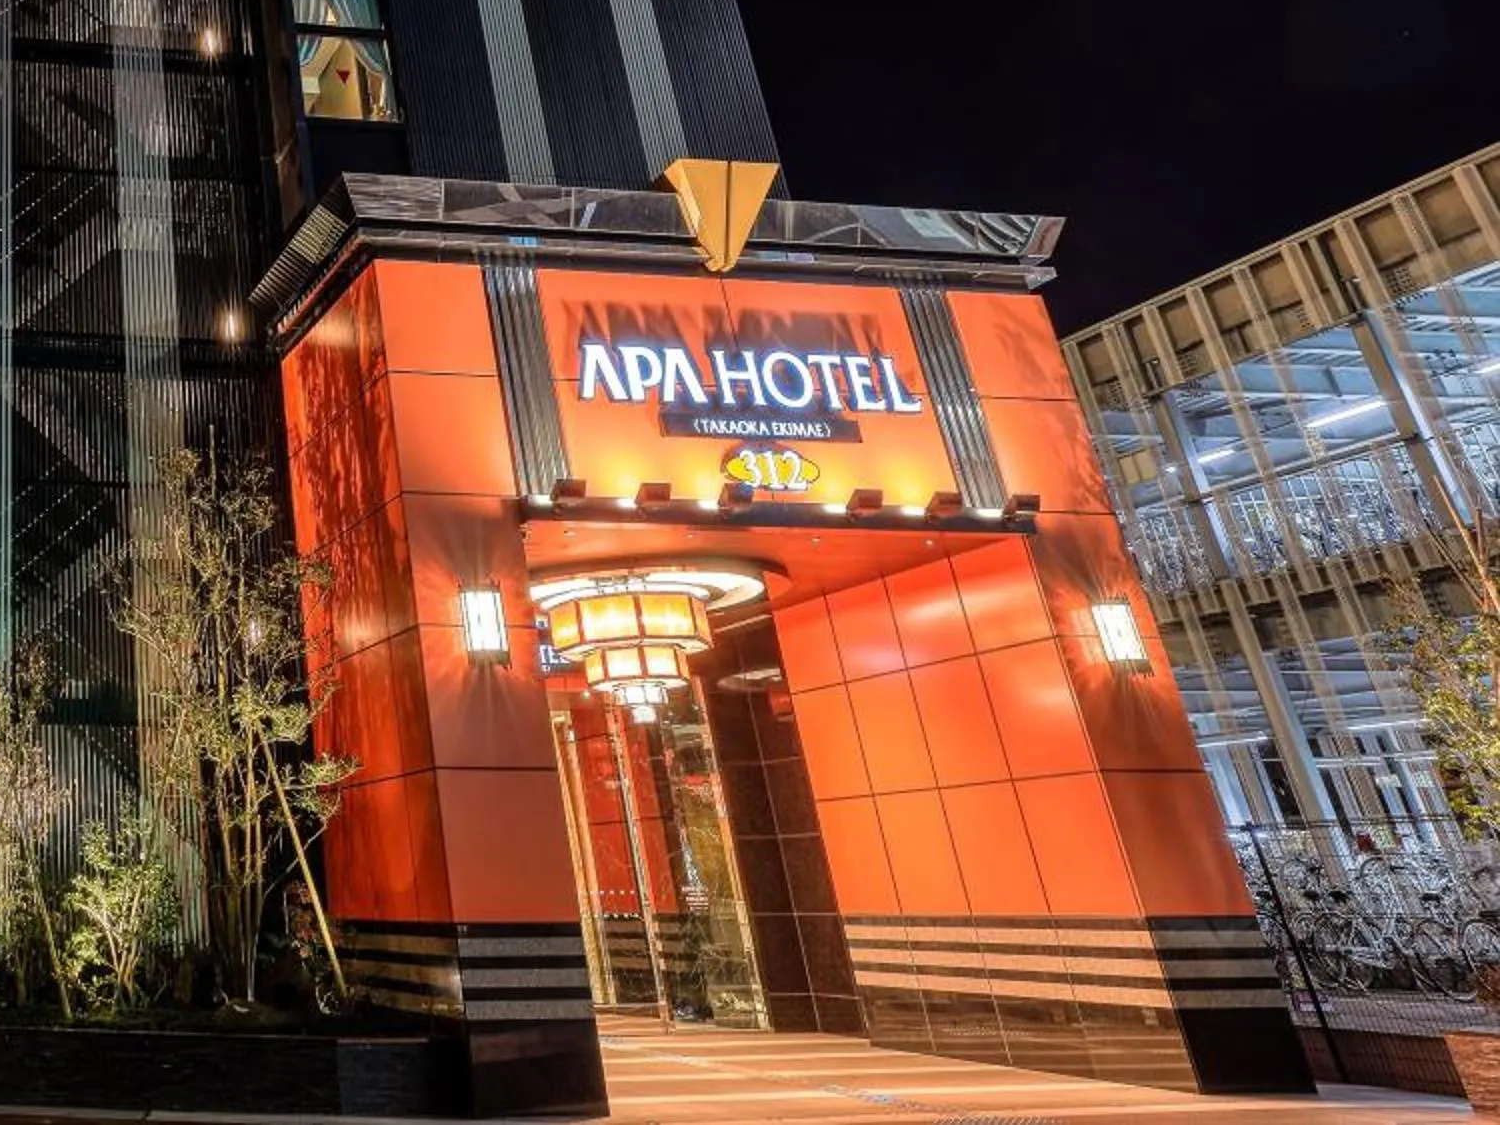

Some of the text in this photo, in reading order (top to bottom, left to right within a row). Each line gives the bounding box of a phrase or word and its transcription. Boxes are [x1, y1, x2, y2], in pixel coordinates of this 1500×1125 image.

[582, 343, 924, 413] APA HOTEL
[739, 449, 808, 491] 312
